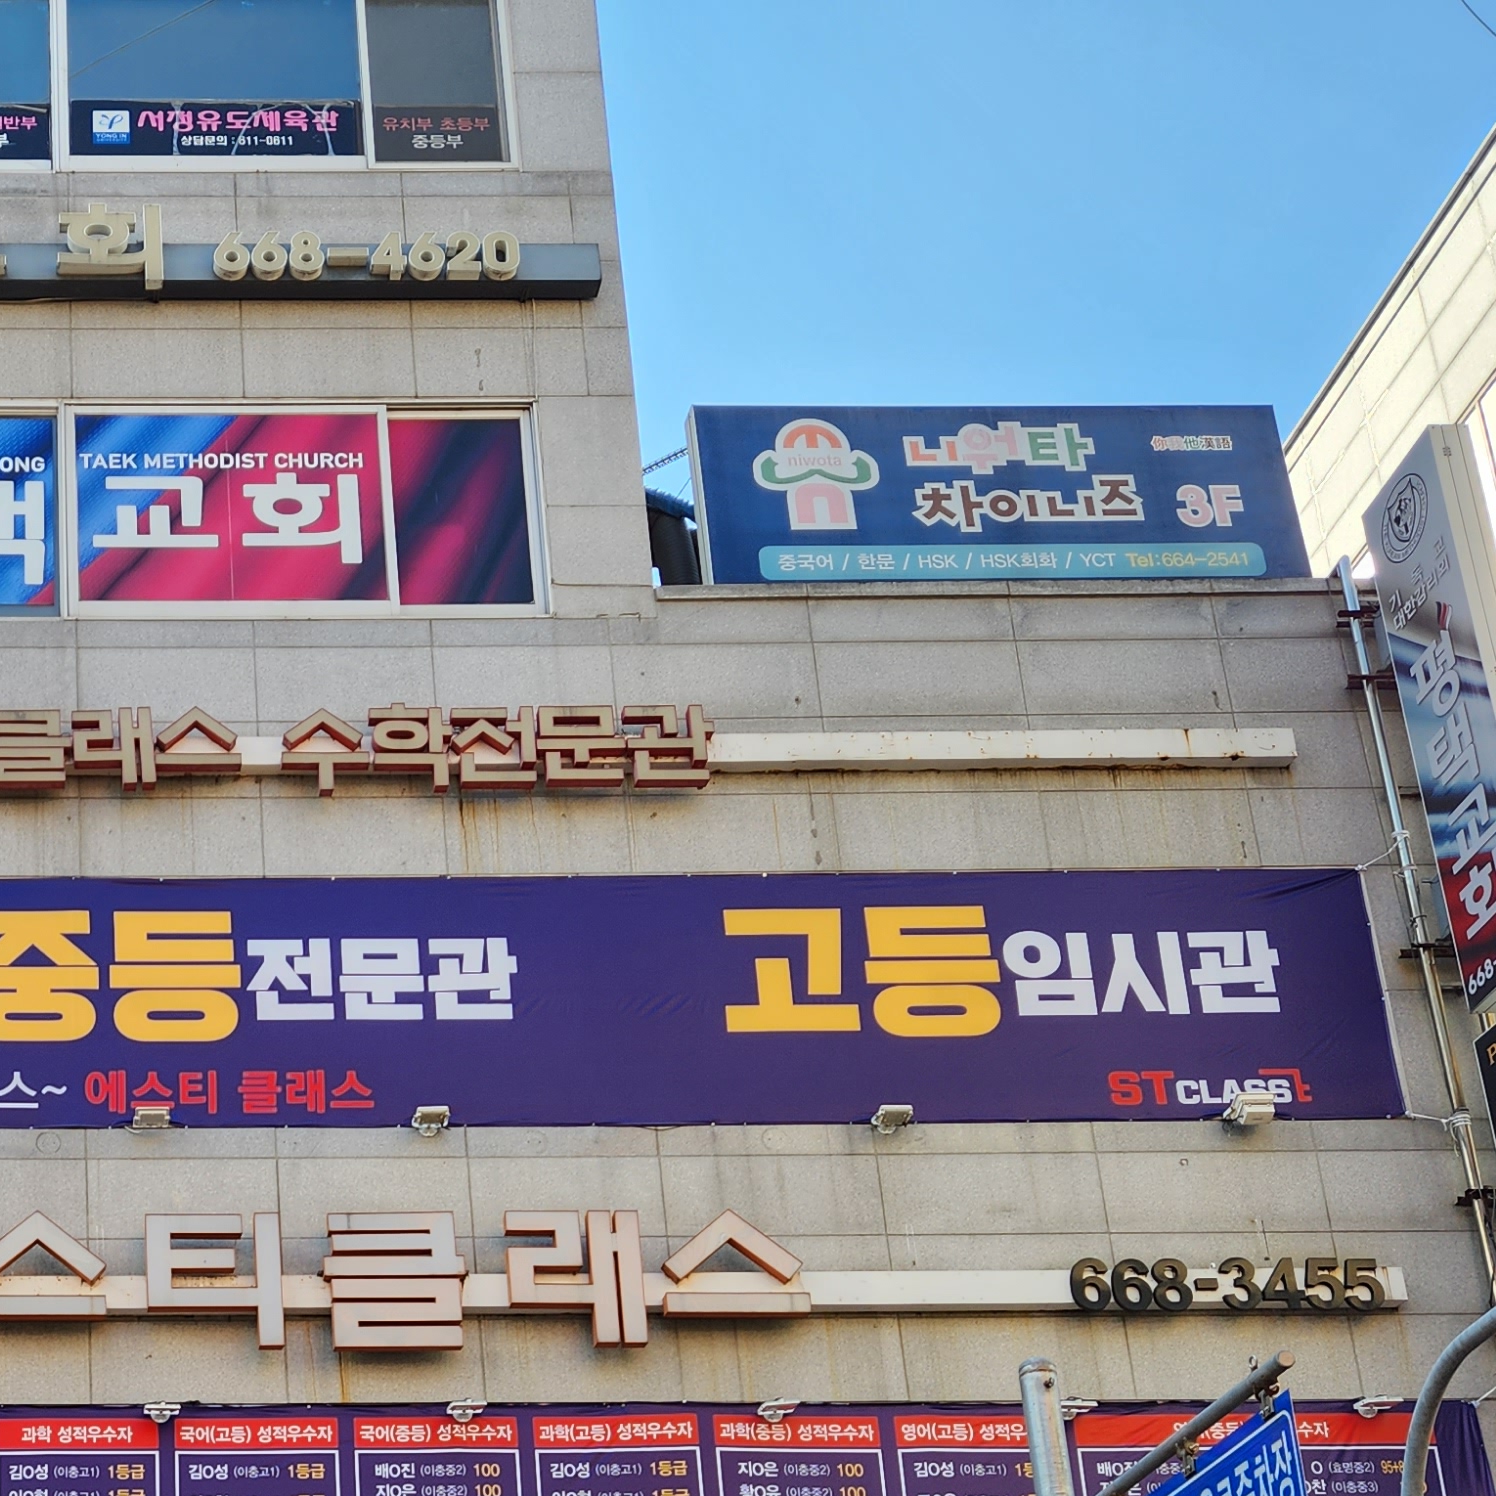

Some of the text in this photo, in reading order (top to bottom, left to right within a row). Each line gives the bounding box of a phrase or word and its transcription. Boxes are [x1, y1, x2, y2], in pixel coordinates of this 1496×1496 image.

[382, 116, 491, 132] 유치부 초등부
[411, 132, 464, 149] 중등부
[213, 230, 521, 280] 668-4620
[903, 421, 1096, 474] 니워타
[79, 452, 138, 470] TAEK
[143, 452, 268, 470] METHODIST
[273, 451, 364, 469] CHURCH
[912, 474, 1245, 533] 차이니즈 3F
[778, 553, 834, 571] 중국어
[857, 552, 896, 570] 한문
[917, 554, 956, 569] HSK
[980, 551, 1058, 569] HSK회화
[1080, 553, 1115, 567] YCT
[281, 701, 714, 797] 수학전문관
[723, 905, 1280, 1038] 고등임시관
[84, 1069, 219, 1114] 에스티
[238, 1069, 375, 1114] 클래스
[1070, 1257, 1385, 1311] 668-3455
[21, 1426, 132, 1443] 과학 성적우수자
[180, 1425, 332, 1443] 국어(고등) 성적우수자
[360, 1424, 512, 1442] 국어(중등) 성적우수자
[540, 1422, 692, 1442] 과학(고등) 성적우수자
[720, 1423, 874, 1442] 과학(중등) 성적우수자
[837, 1463, 864, 1478] 100
